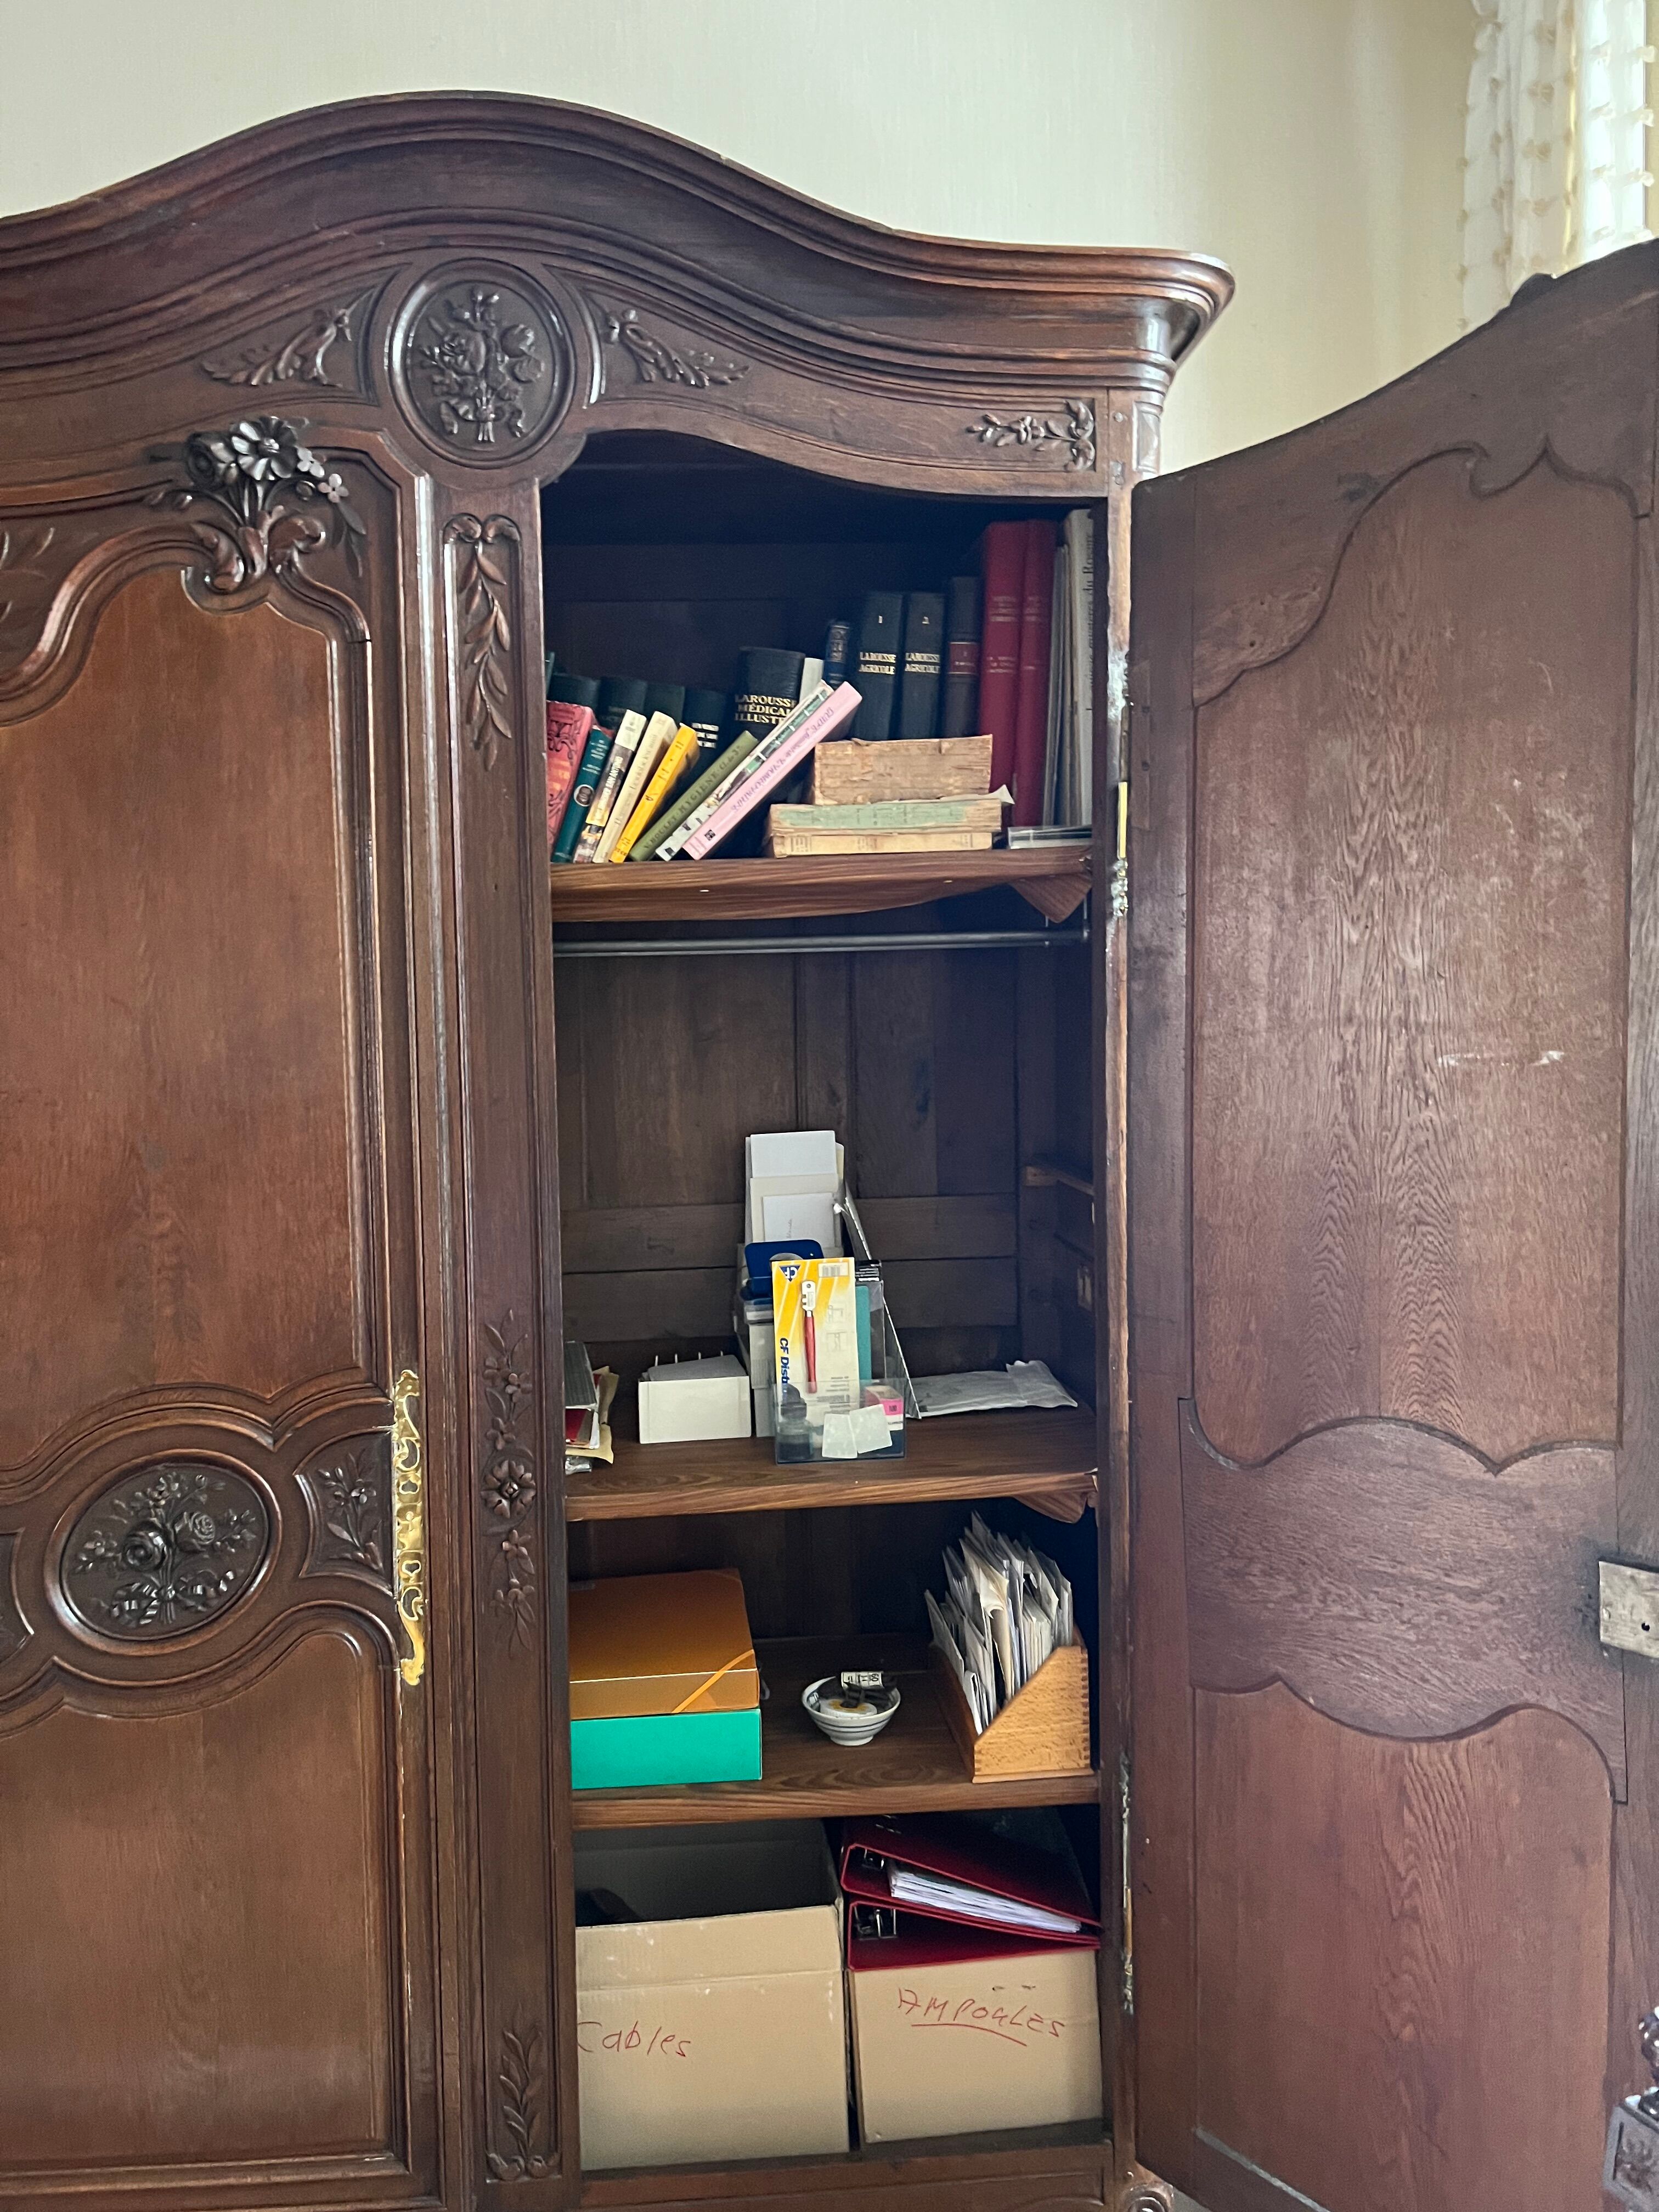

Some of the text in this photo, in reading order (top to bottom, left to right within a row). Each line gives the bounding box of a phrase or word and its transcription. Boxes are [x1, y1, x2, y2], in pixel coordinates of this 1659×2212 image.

[922, 616, 930, 624] 2
[780, 1337, 789, 1354] CF
[577, 2020, 691, 2057] Cables
